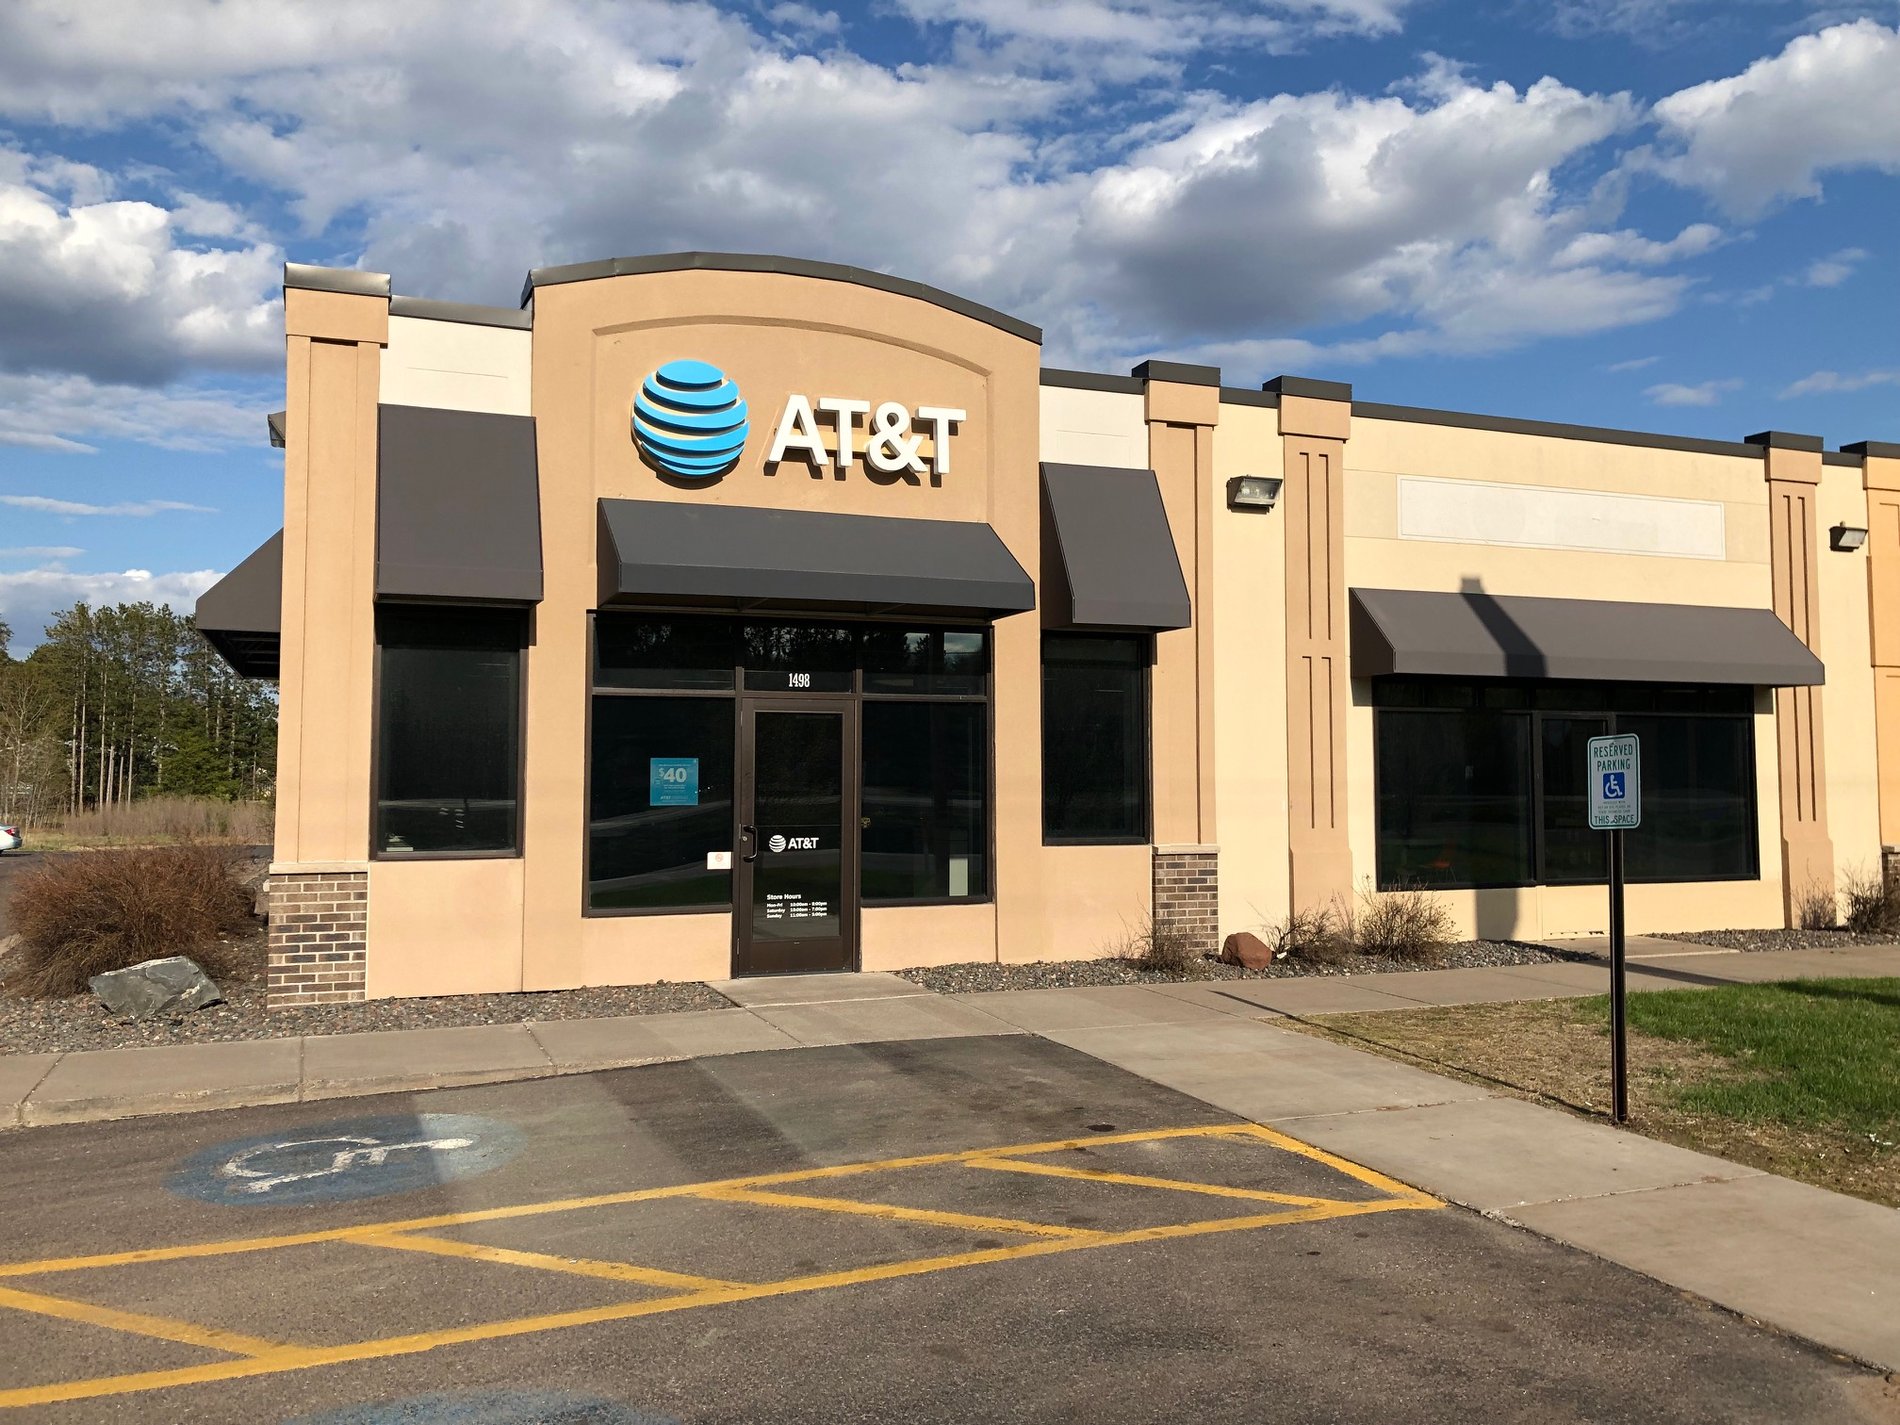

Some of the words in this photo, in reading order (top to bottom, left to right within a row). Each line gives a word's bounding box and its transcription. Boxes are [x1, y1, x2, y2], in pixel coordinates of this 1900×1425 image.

[768, 394, 967, 475] AT&T
[788, 673, 810, 687] 1498
[1593, 744, 1633, 758] RESERVED
[1597, 759, 1631, 771] PARKING
[658, 767, 687, 783] $40
[1594, 815, 1610, 825] THIS
[1613, 814, 1635, 824] SPACE
[788, 837, 819, 849] AT&T
